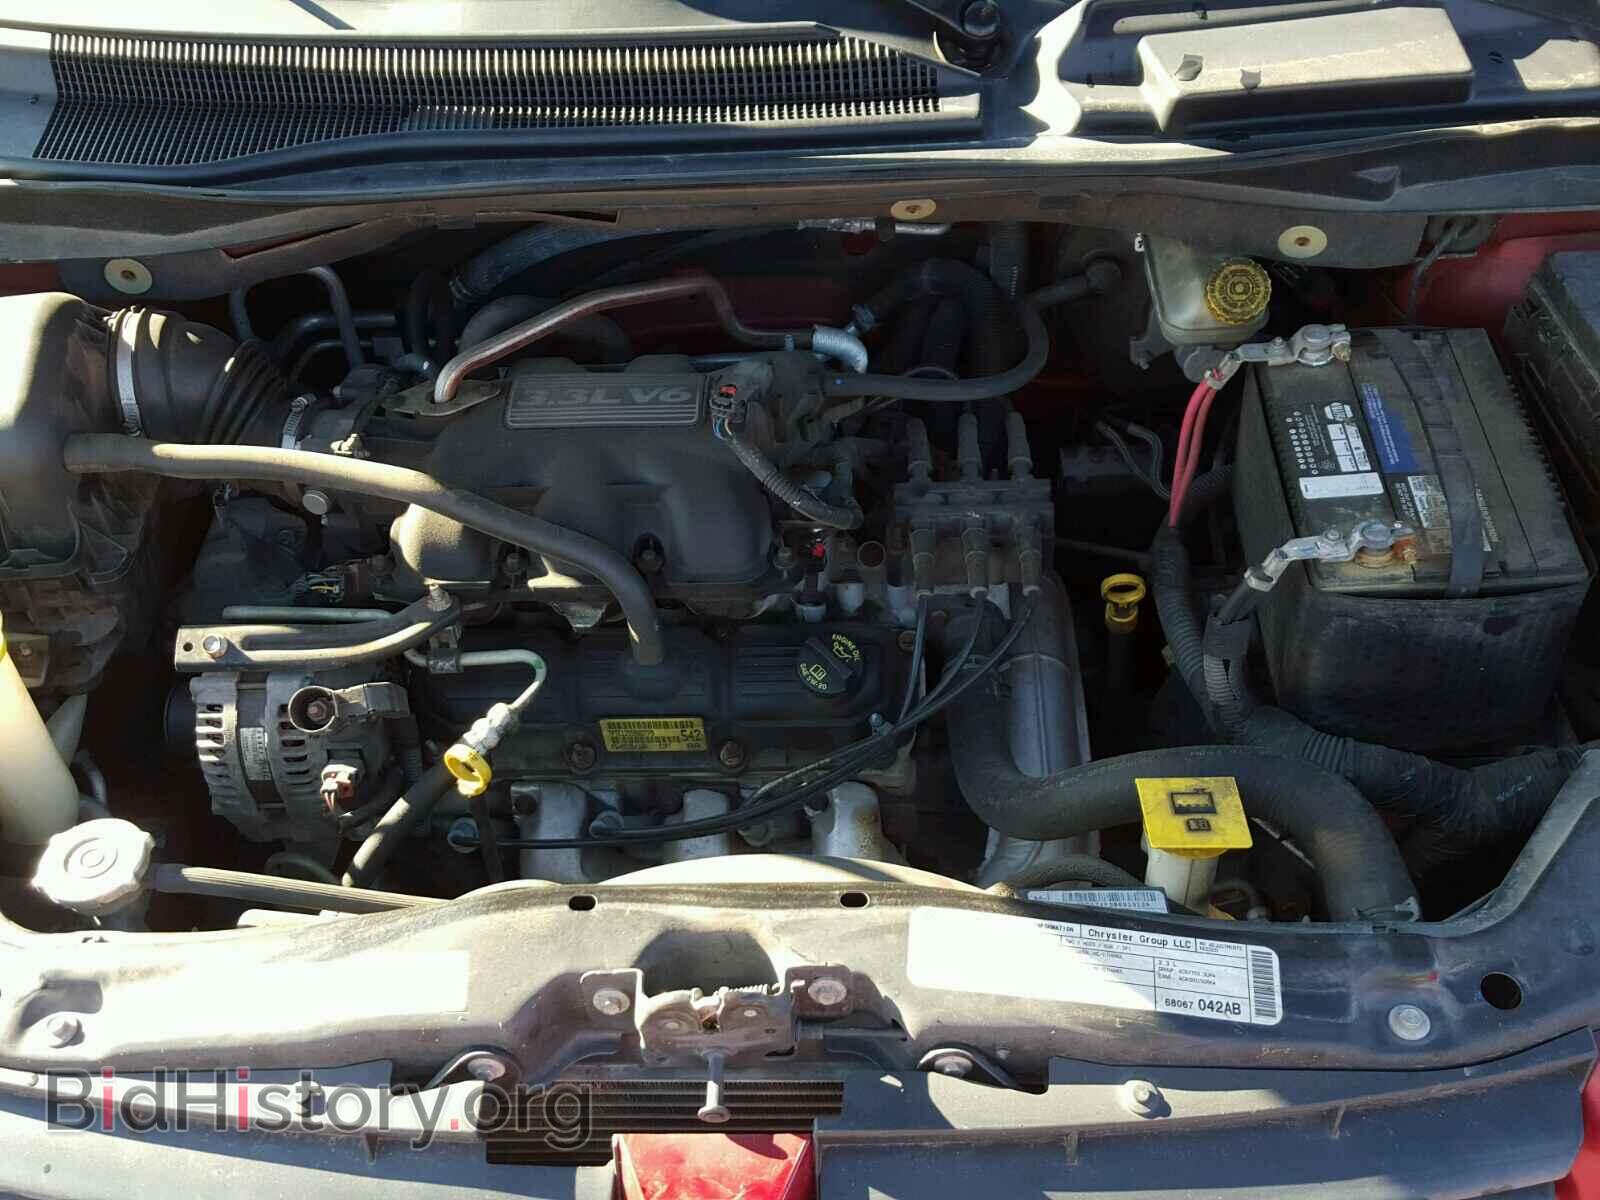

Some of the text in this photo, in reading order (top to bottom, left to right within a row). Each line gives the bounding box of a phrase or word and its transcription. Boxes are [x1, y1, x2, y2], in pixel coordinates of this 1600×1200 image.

[516, 386, 693, 406] 3.3L V6
[832, 633, 857, 651] ENGINE
[680, 728, 702, 742] 542
[1088, 928, 1133, 942] Chrysler
[1139, 934, 1168, 949] Group
[1173, 939, 1192, 949] LLC
[1164, 997, 1242, 1016] 68067 042AB
